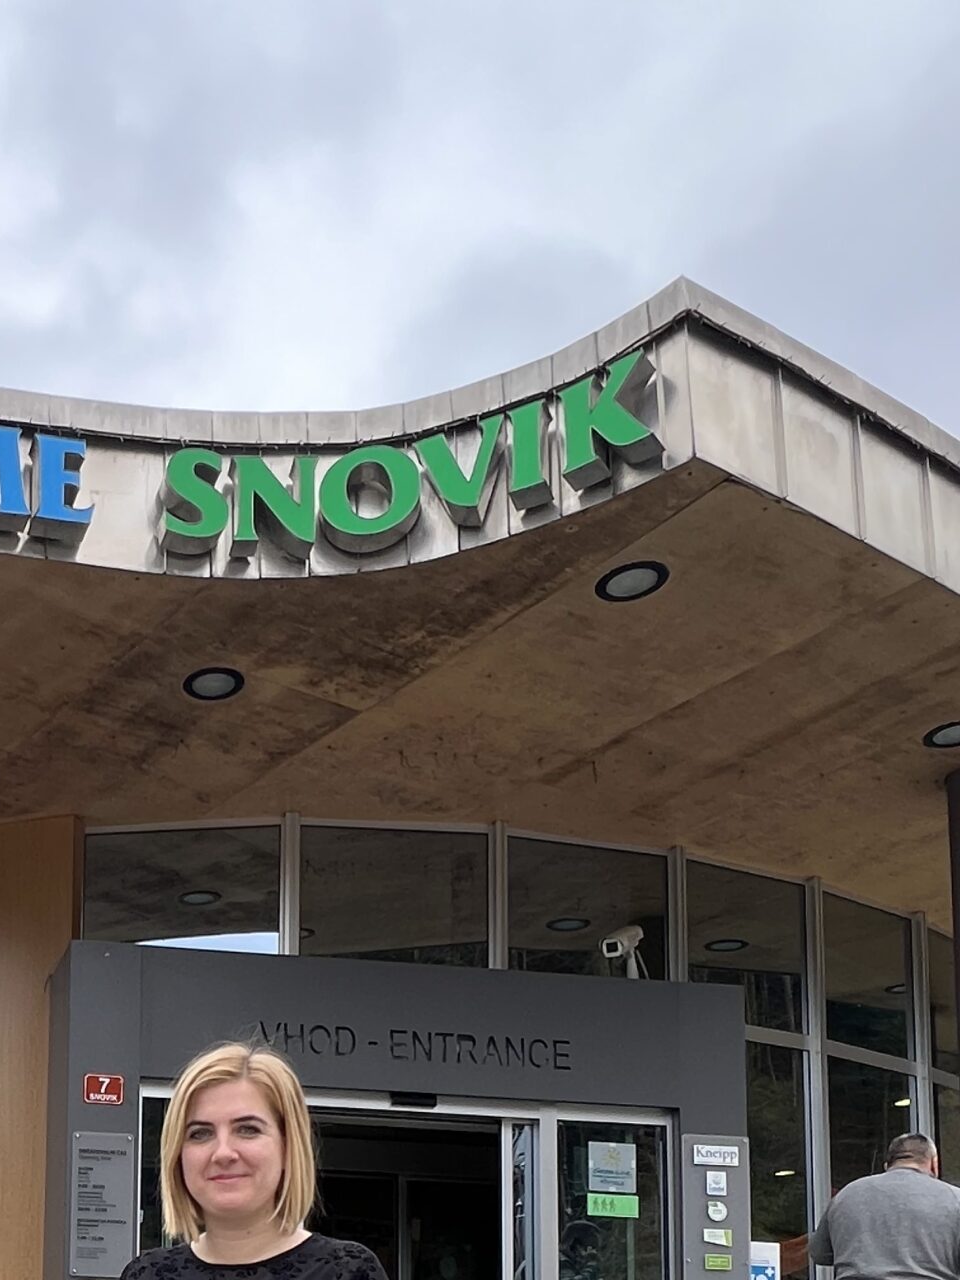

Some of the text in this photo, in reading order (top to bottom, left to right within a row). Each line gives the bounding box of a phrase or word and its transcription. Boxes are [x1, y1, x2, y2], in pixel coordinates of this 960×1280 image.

[165, 349, 654, 544] SNOVIK
[259, 1020, 356, 1056] VHOD
[389, 1029, 572, 1071] ENTRANCE
[98, 1077, 111, 1093] 7
[696, 1145, 737, 1164] Kneipp
